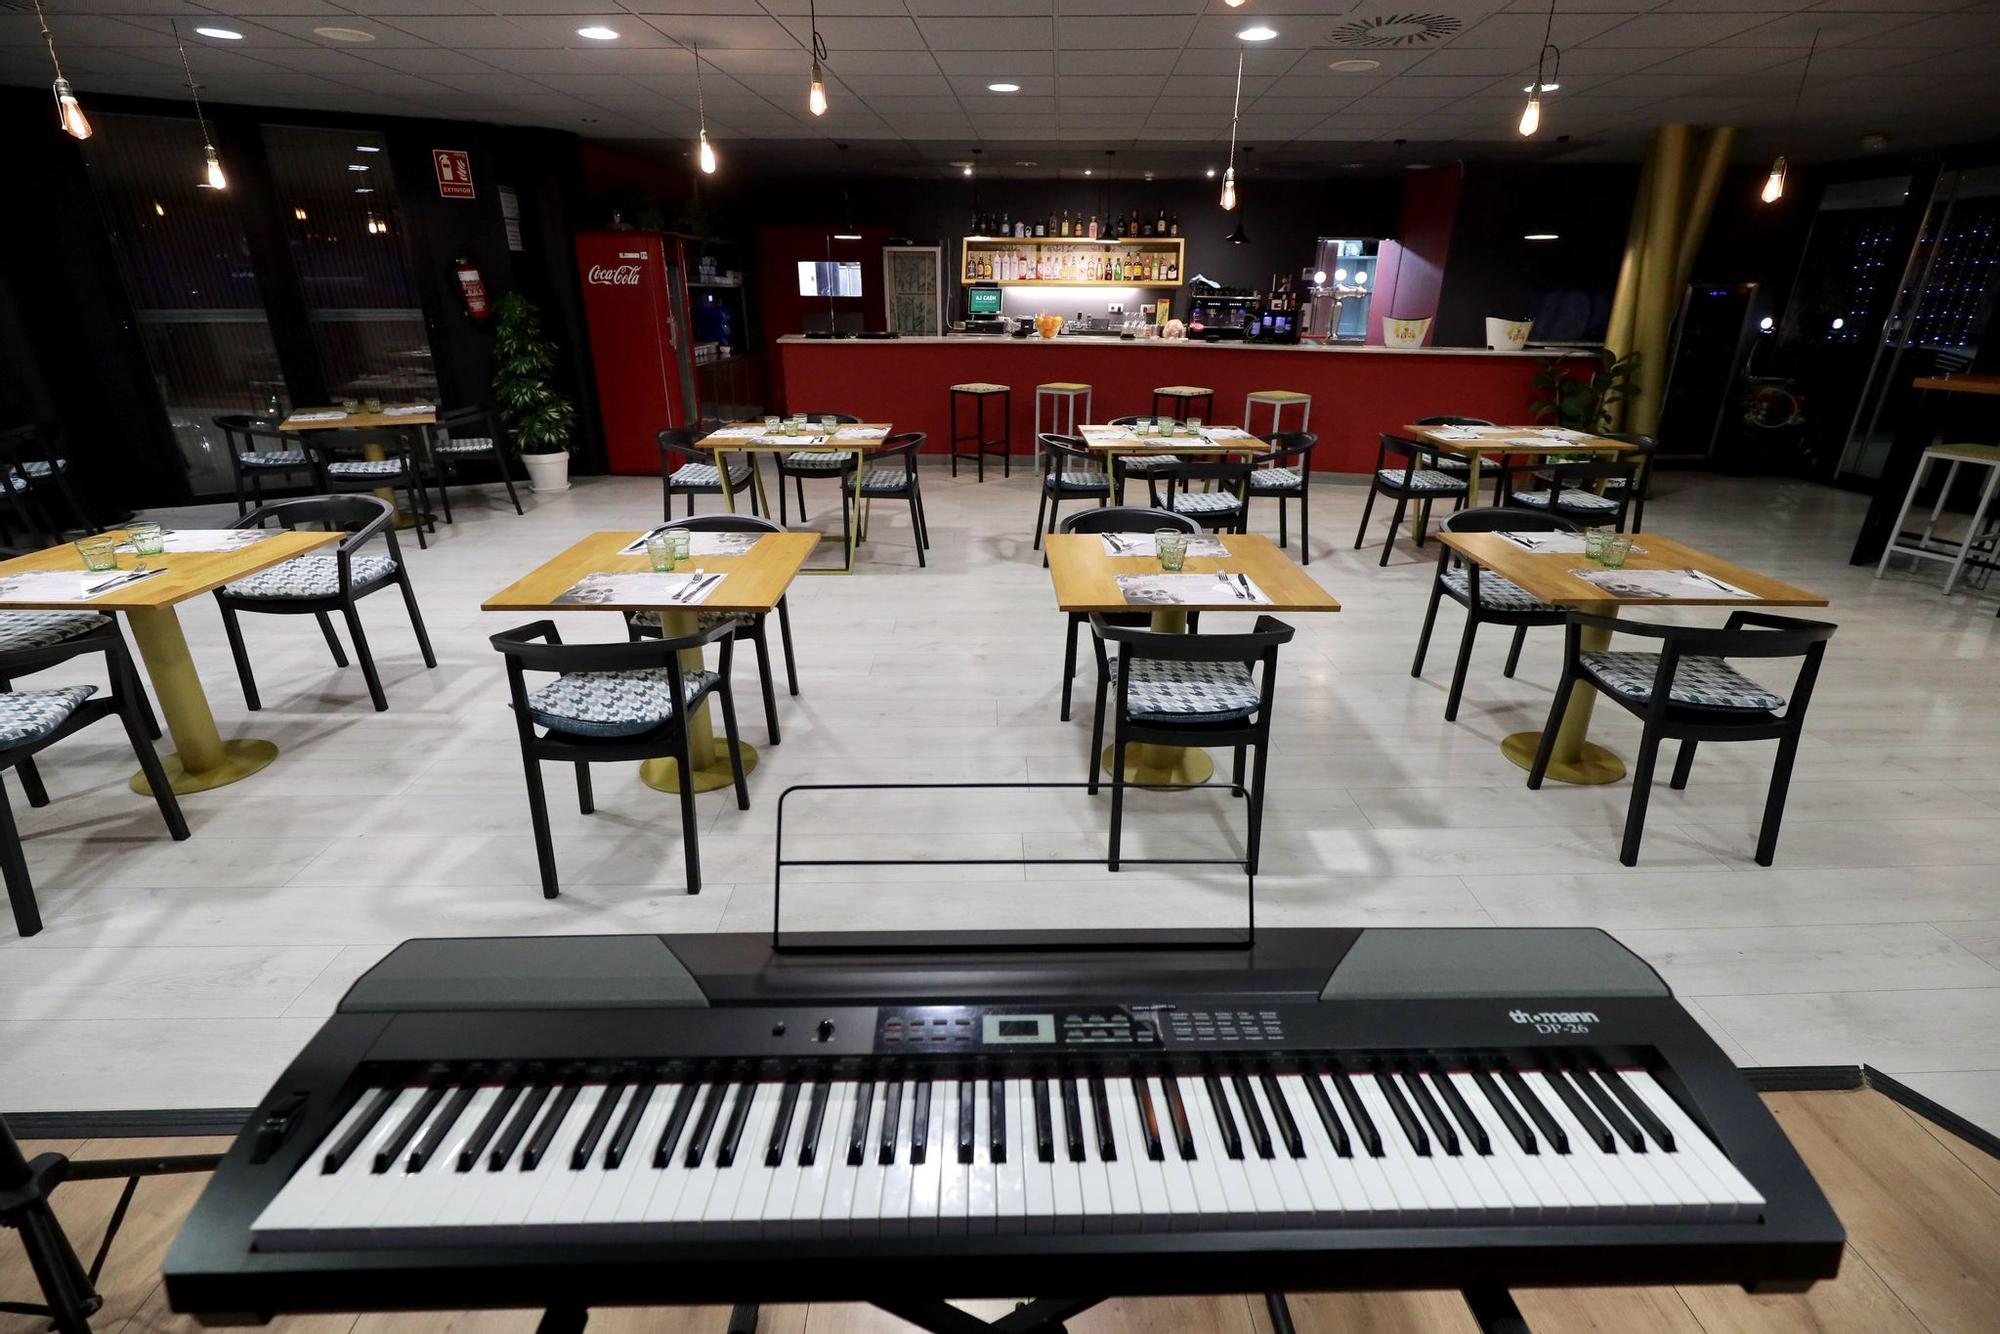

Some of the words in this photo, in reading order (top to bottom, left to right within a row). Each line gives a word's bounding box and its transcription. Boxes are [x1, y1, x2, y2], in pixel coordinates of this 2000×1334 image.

[588, 265, 641, 286] Coca-Cola
[1509, 1009, 1600, 1023] thomann
[1534, 1023, 1590, 1034] DP-26
